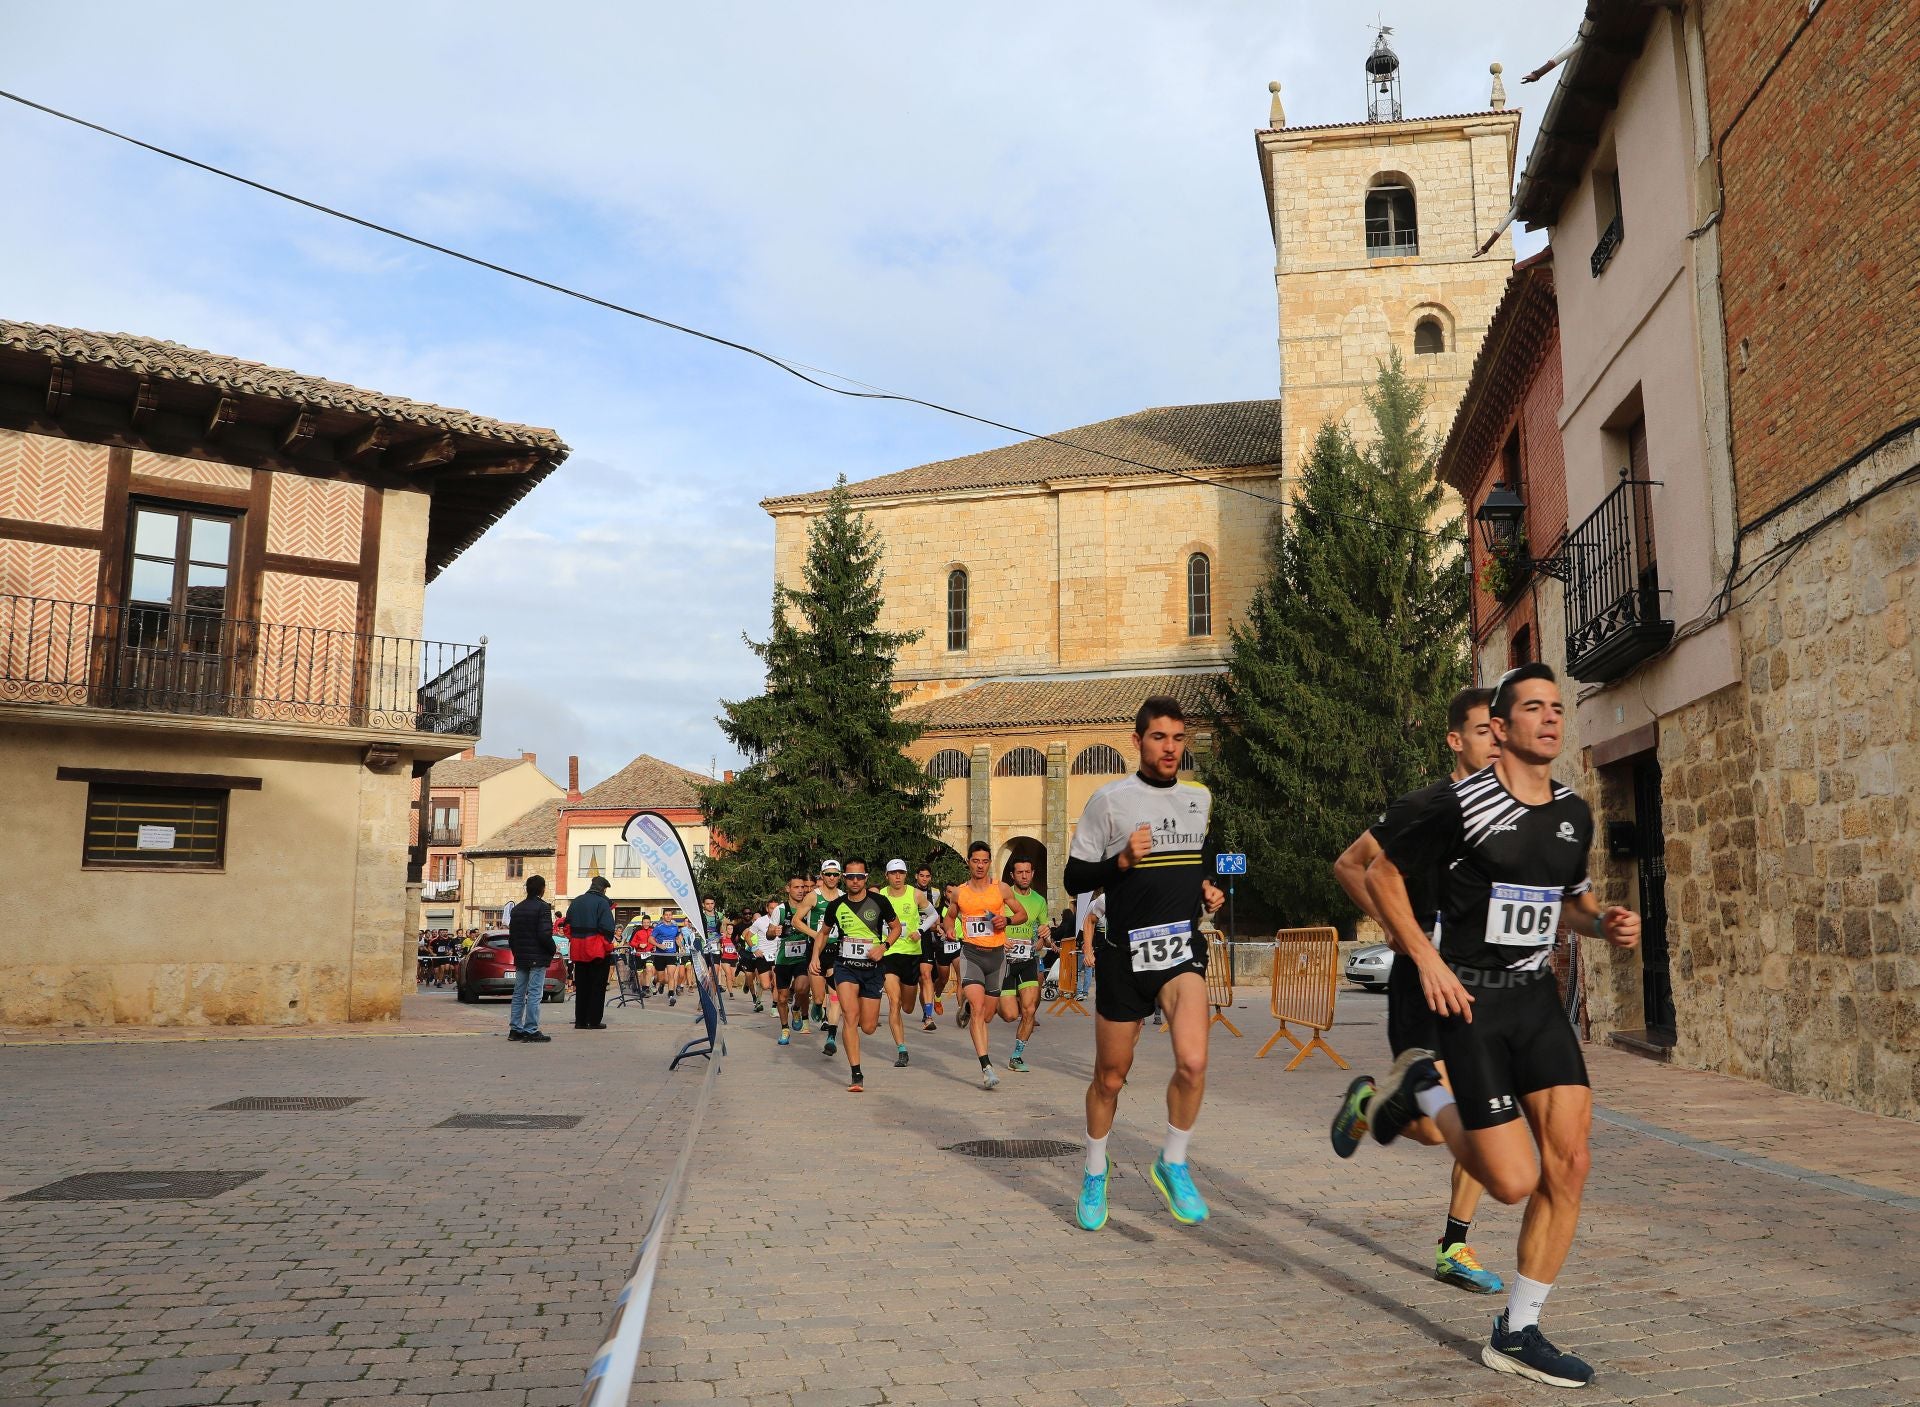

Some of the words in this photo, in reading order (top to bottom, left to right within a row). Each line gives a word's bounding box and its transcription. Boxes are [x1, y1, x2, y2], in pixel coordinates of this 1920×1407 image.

[1152, 833, 1206, 847] STUDILLO
[1501, 903, 1553, 935] 106
[972, 922, 986, 933] 10
[791, 945, 802, 954] 41
[851, 944, 865, 955] 15
[1013, 945, 1026, 955] 28
[1139, 936, 1184, 963] 132
